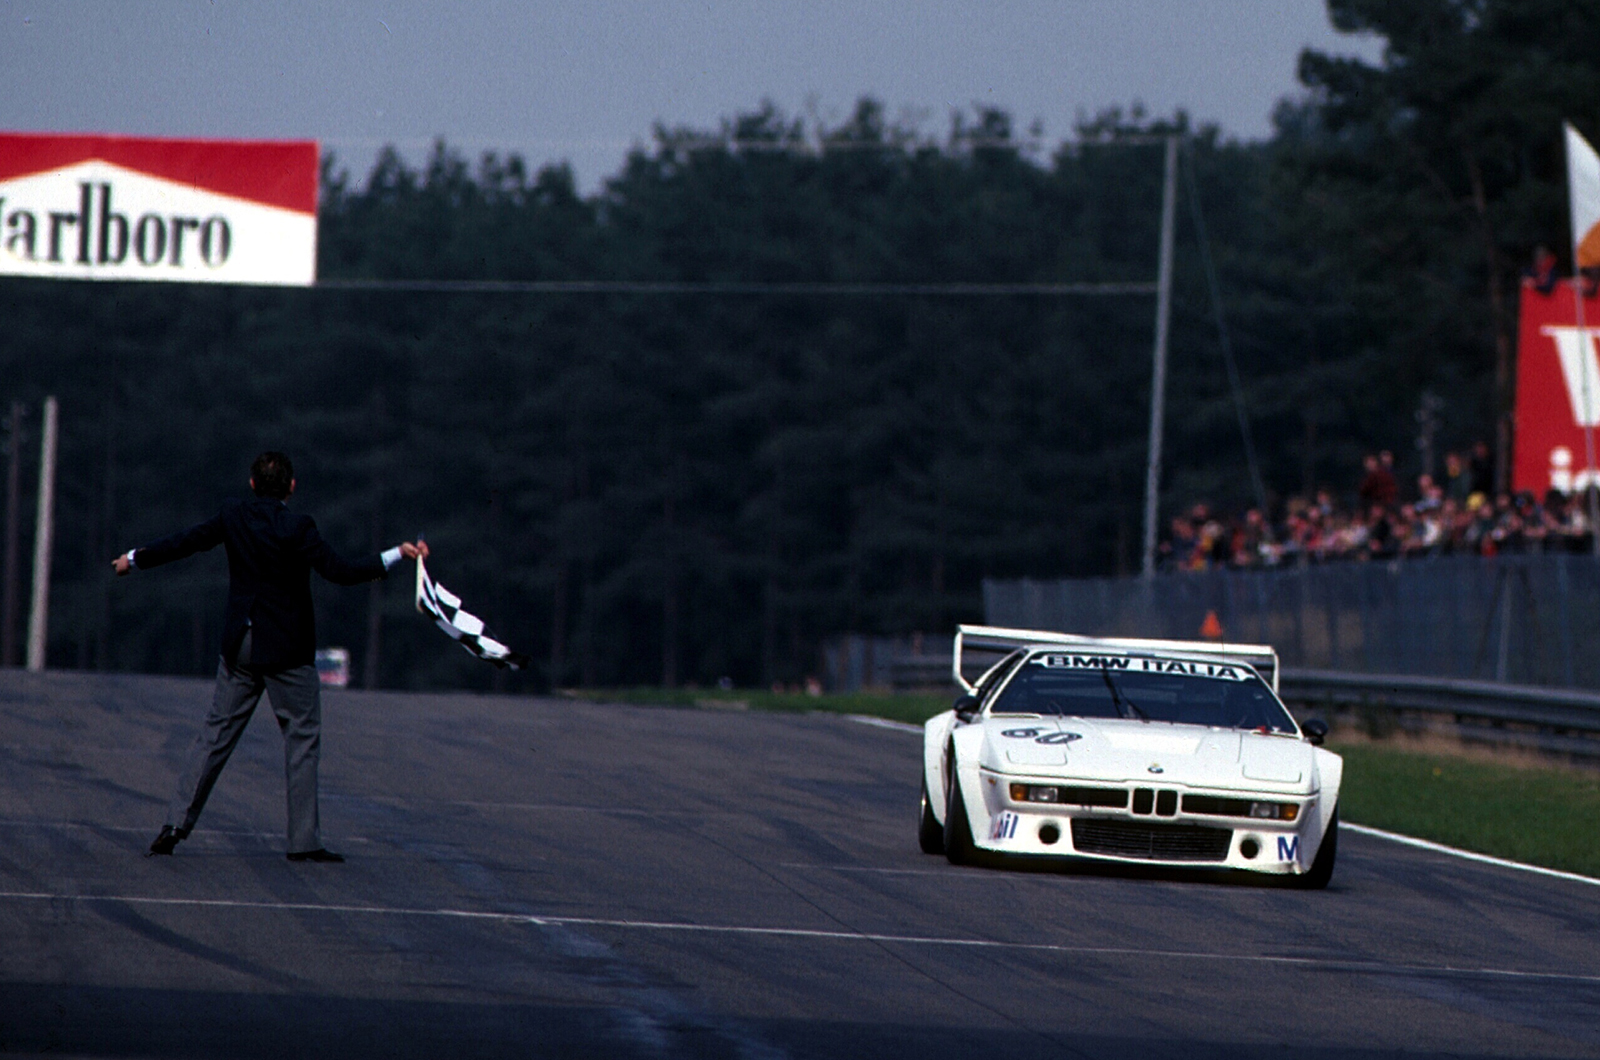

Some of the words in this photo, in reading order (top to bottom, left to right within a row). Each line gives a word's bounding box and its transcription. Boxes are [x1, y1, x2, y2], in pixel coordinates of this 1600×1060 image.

[0, 181, 232, 268] arlboro
[1047, 656, 1130, 670] BMW
[1144, 659, 1238, 679] ITALIA
